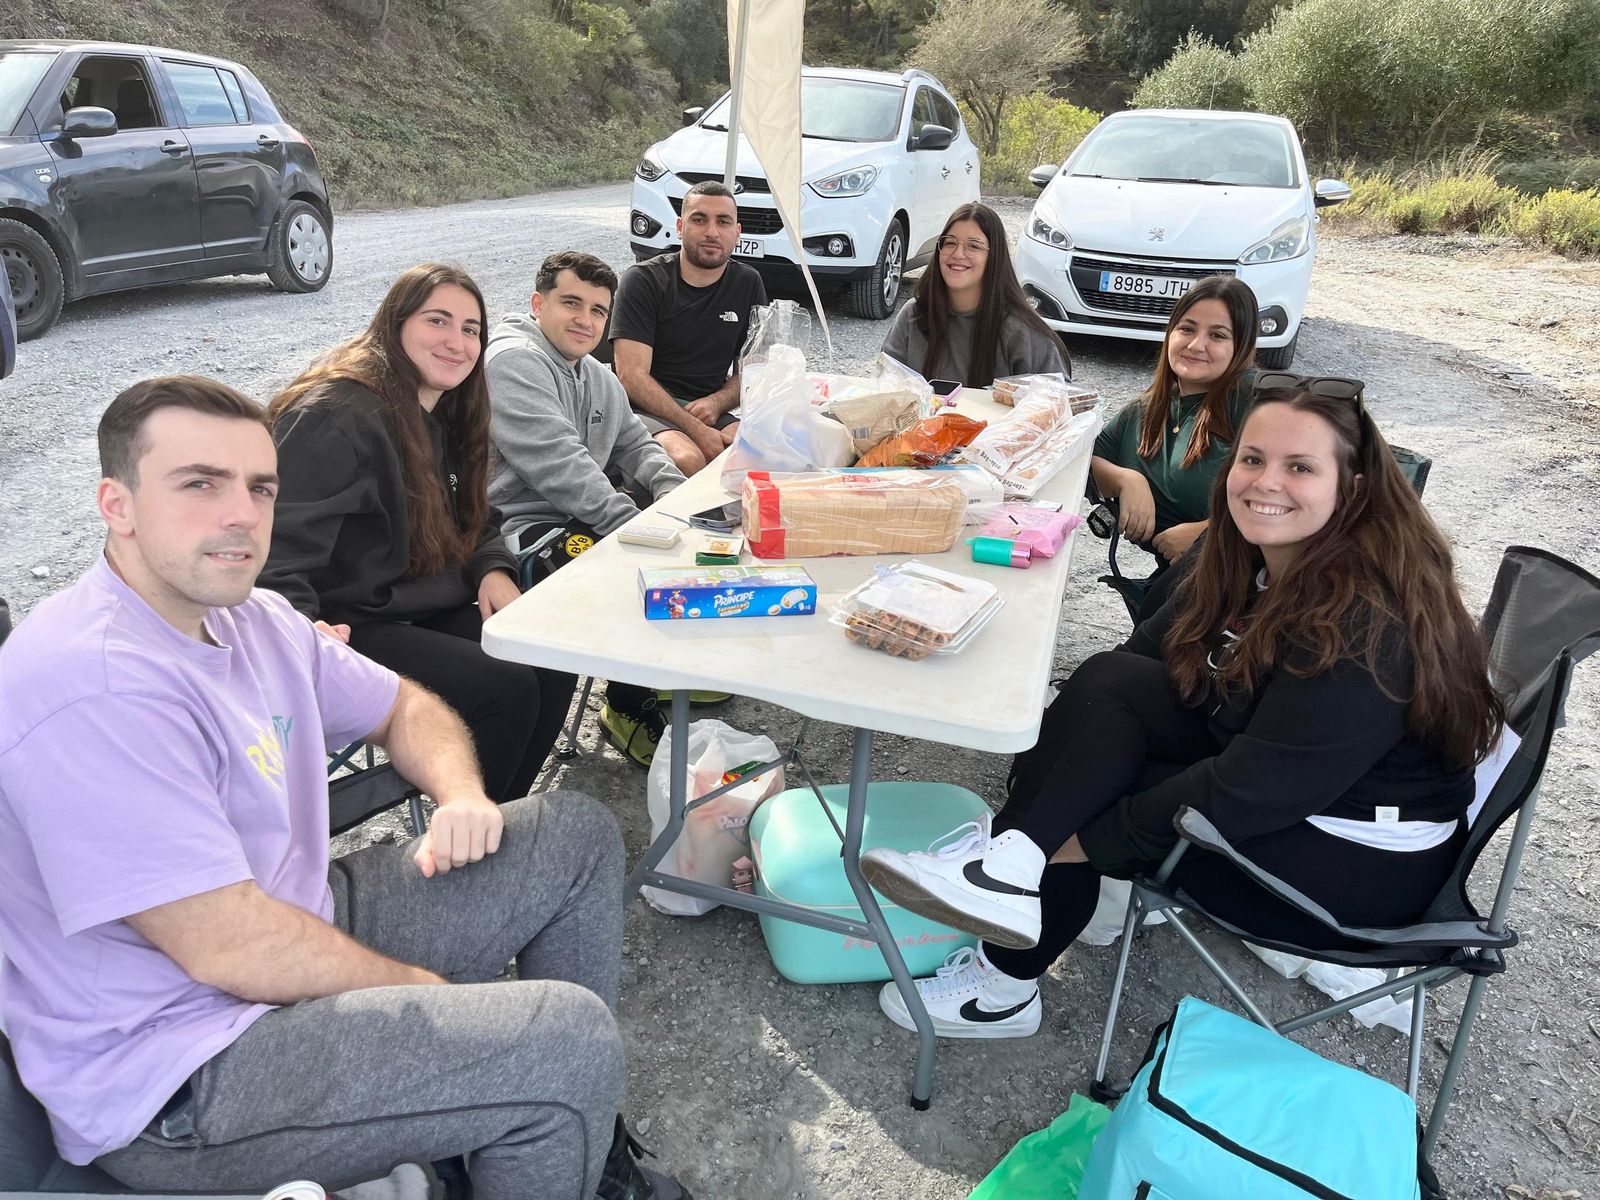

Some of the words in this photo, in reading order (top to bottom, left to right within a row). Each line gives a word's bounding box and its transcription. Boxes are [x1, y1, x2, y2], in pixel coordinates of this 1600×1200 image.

[735, 240, 759, 255] HZP
[1113, 275, 1154, 293] 8985
[1159, 280, 1190, 296] JTH
[568, 537, 589, 554] BVB
